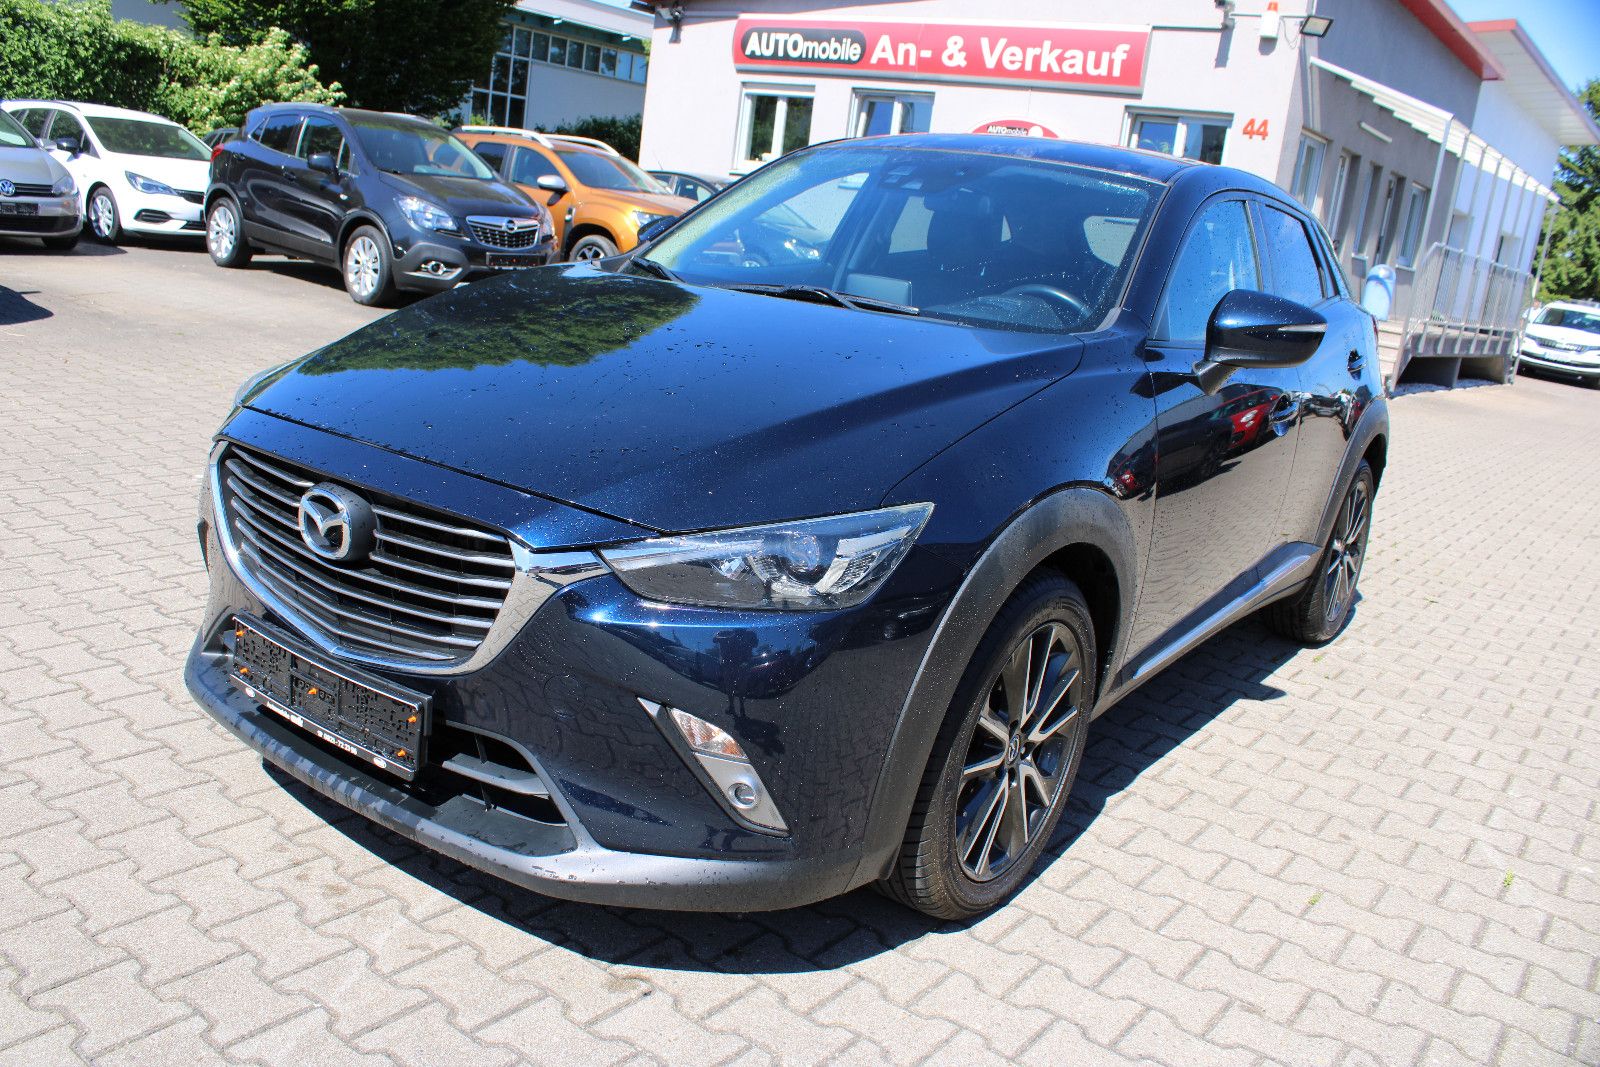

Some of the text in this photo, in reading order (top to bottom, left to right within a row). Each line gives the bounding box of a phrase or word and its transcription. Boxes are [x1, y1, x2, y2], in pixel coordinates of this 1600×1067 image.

[745, 31, 1131, 77] AUTOmobile An- & Verkauf
[1242, 118, 1269, 140] 44
